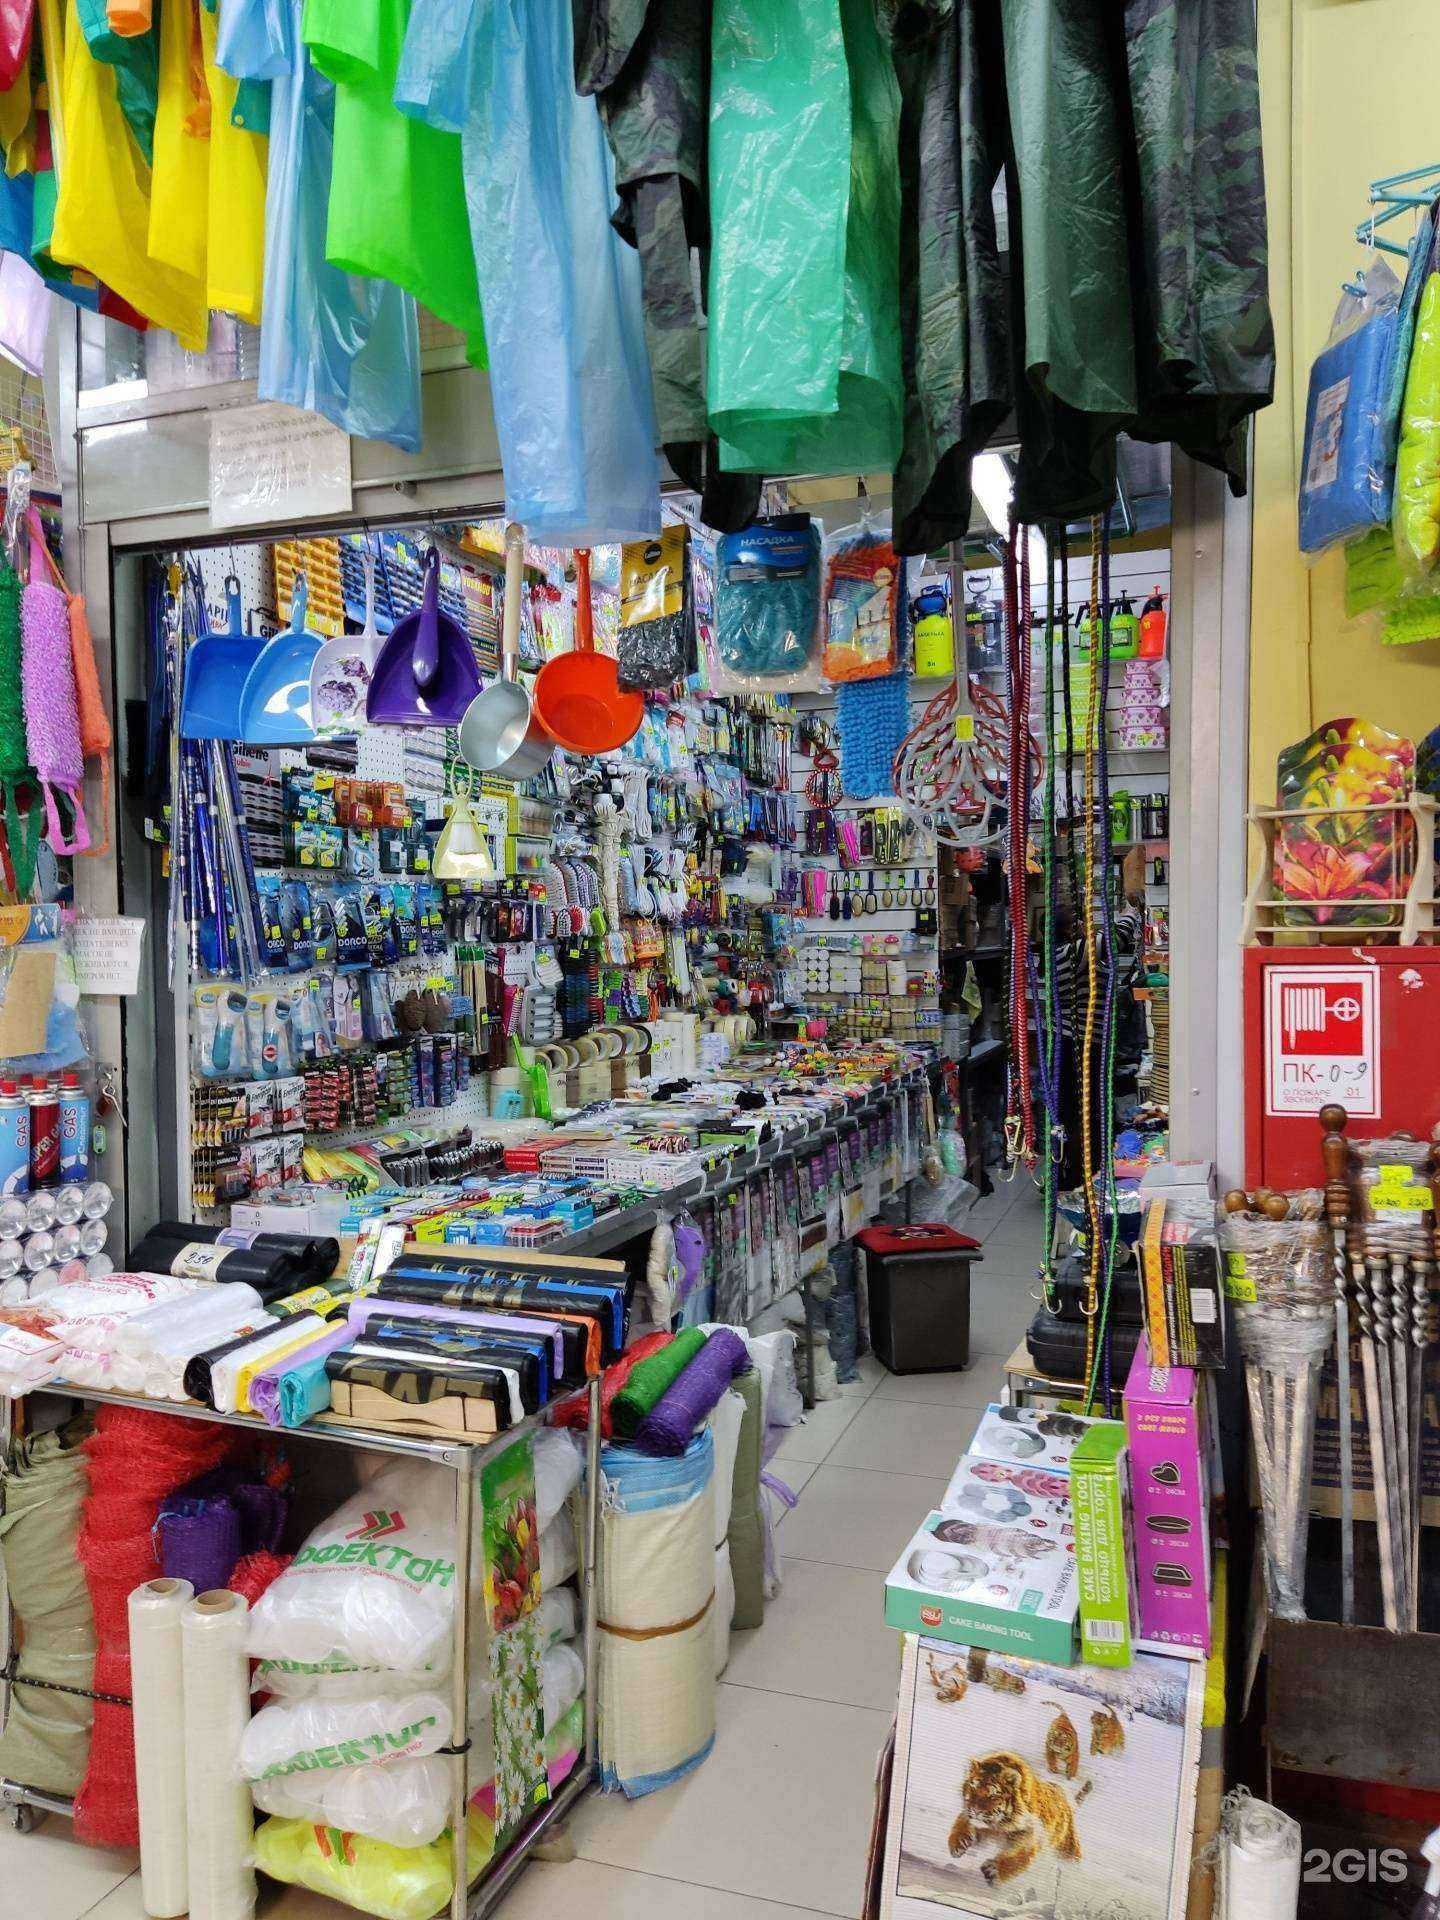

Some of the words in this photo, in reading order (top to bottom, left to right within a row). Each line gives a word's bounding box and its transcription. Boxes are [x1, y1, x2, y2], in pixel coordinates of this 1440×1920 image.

[337, 936, 368, 948] DORCO
[16, 1115, 27, 1149] GAS
[63, 1107, 78, 1139] GAS
[1077, 1473, 1089, 1508] TOOL
[1079, 1511, 1093, 1563] BAKING
[1095, 1518, 1108, 1547] ДЛЯ
[1084, 1567, 1096, 1602] CAKE
[1097, 1550, 1112, 1603] КОЛЬЦО
[949, 1616, 974, 1629] CAKE
[973, 1620, 1009, 1637] BAKING
[1007, 1627, 1035, 1642] TOOL
